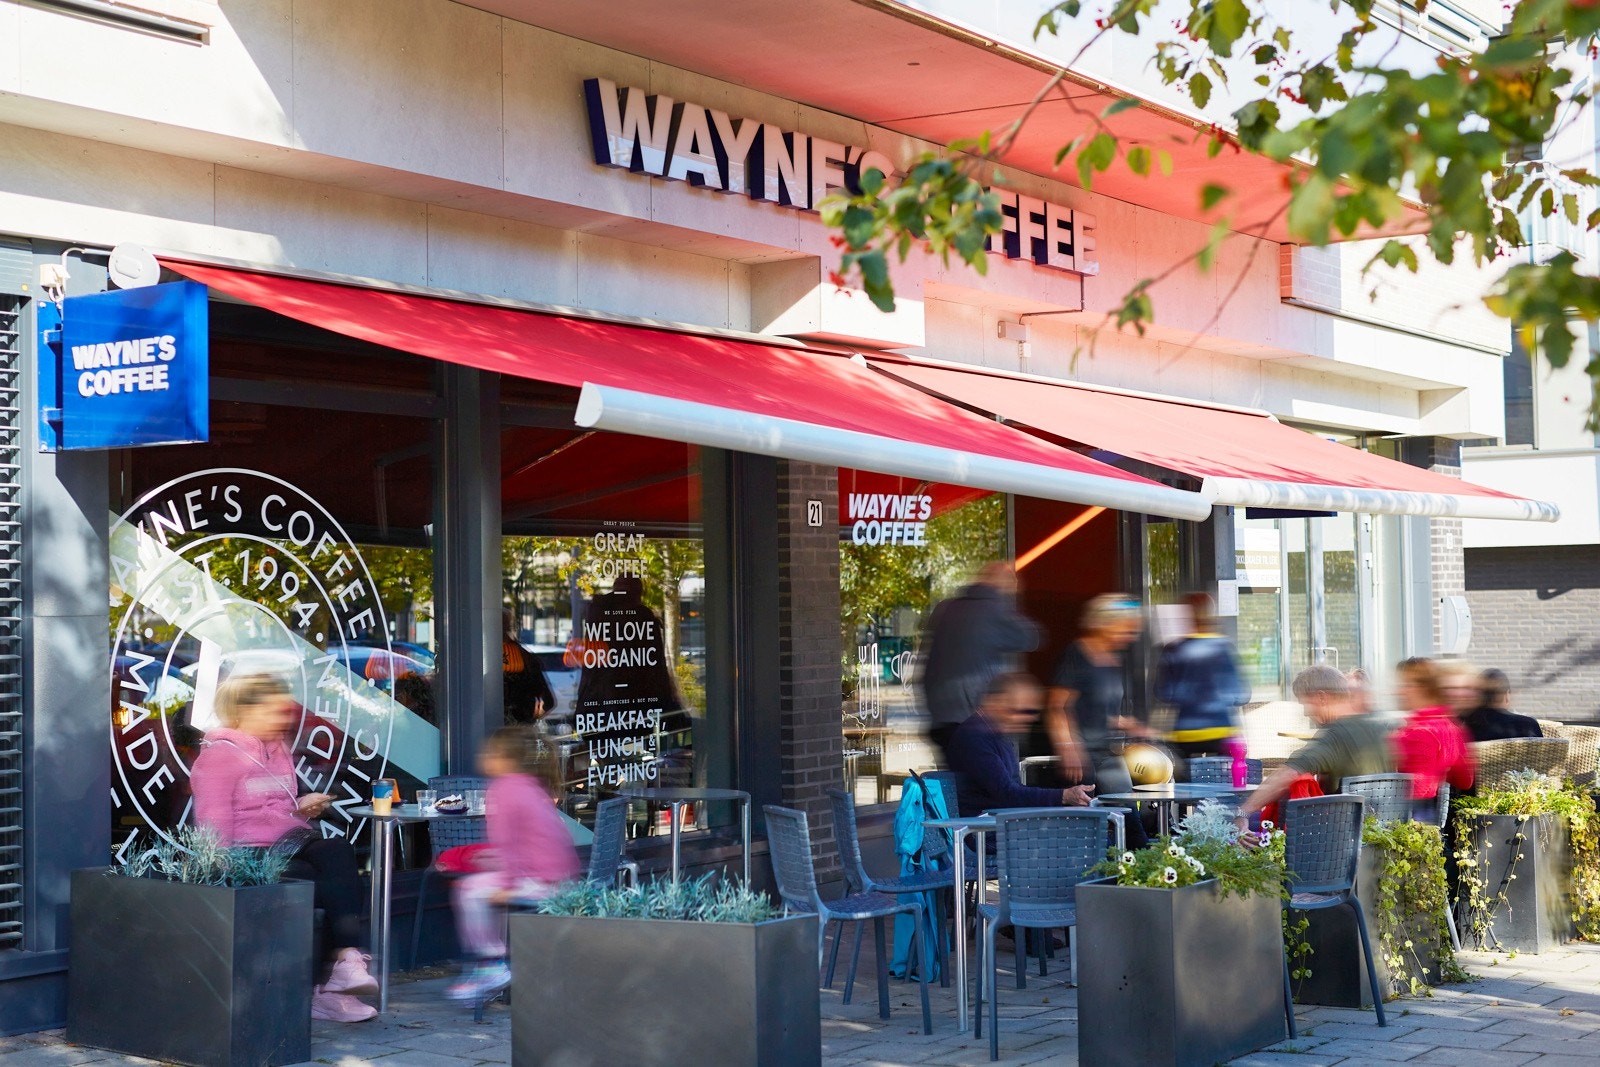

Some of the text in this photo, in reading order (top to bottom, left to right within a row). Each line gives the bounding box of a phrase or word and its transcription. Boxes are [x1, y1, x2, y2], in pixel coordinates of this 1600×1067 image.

[71, 334, 176, 370] WAYNE'S
[78, 364, 170, 398] COFFEE
[810, 503, 821, 525] 21
[849, 494, 933, 520] WAYNE'S
[594, 532, 645, 553] GREAT
[852, 520, 926, 547] COFFEE
[109, 485, 376, 640] AYNE'S COFFEE
[591, 558, 648, 579] COFFEE
[239, 550, 321, 629] 1994
[586, 621, 655, 642] WE LOVE
[583, 647, 658, 669] ORGANIC
[295, 653, 341, 791] EDEN
[576, 708, 667, 735] BREAKFAST,
[589, 733, 656, 760] LUNCH &
[588, 761, 658, 788] EVENING
